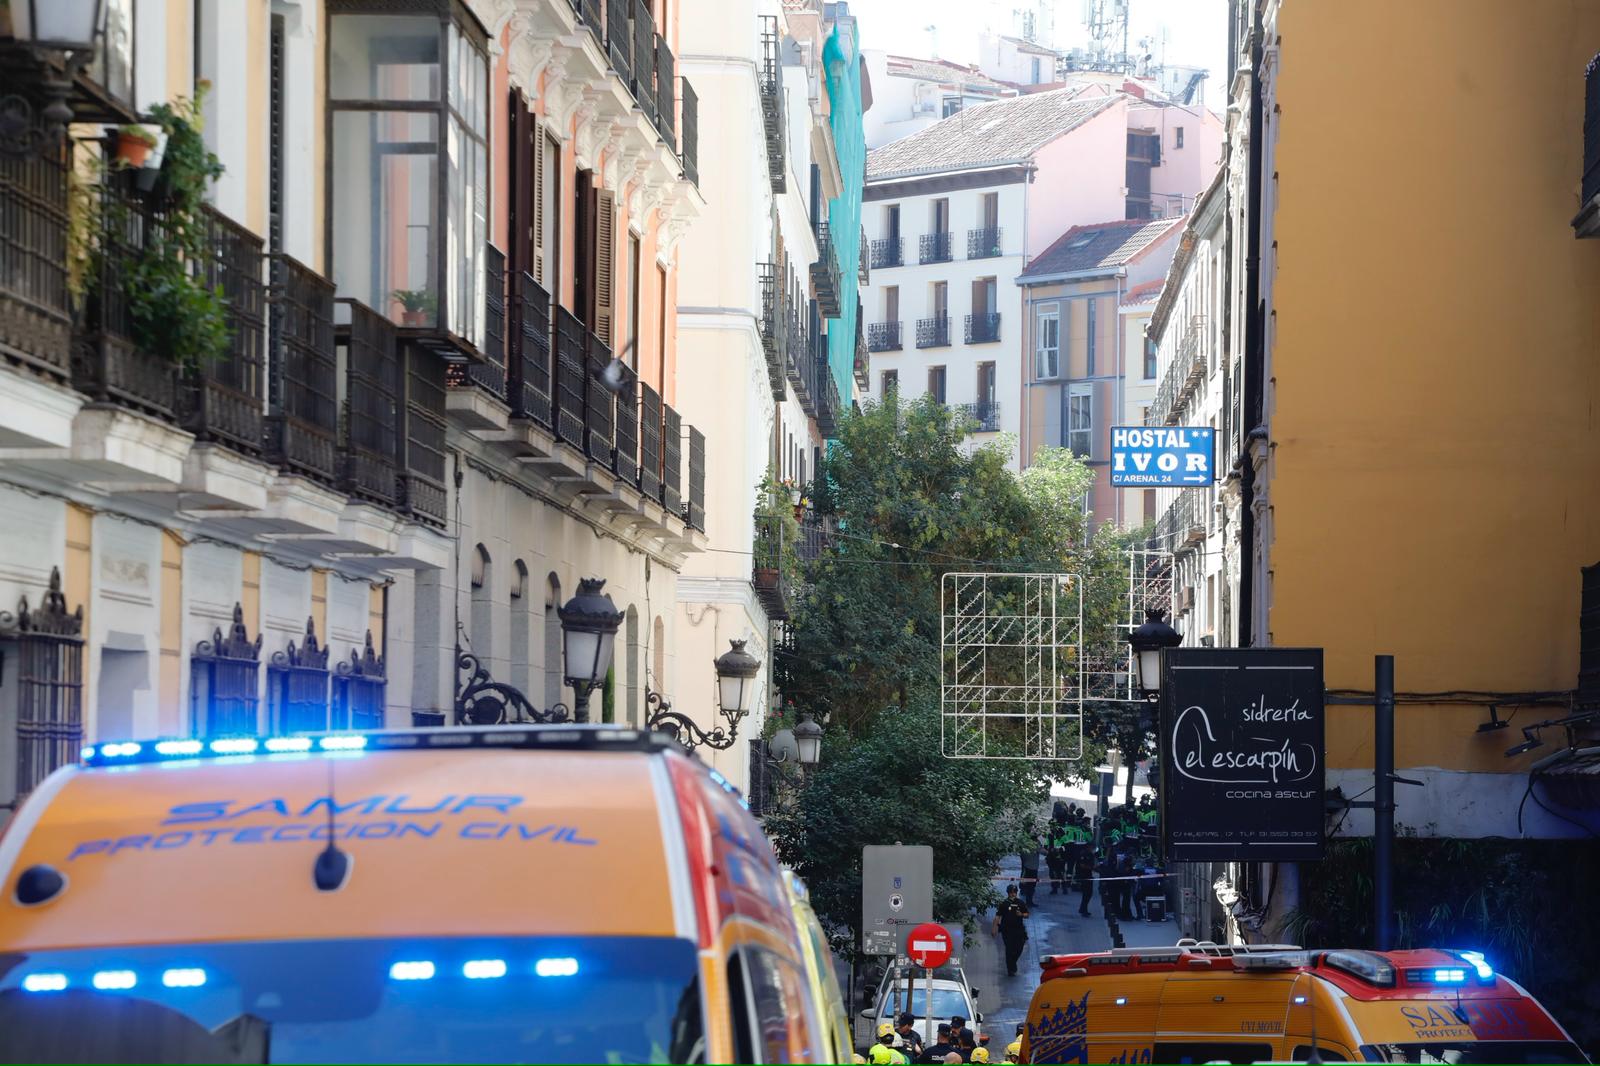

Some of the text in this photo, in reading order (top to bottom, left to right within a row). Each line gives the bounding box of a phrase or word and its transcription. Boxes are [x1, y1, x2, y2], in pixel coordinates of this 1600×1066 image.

[1113, 429, 1190, 448] HOSTAL
[1113, 452, 1208, 472] IVOR
[1113, 475, 1172, 483] C/ ARENAL 24
[1242, 694, 1314, 722] sidrería
[1211, 738, 1302, 784] escarpín
[1225, 790, 1318, 799] cocina astur
[161, 795, 524, 825] SAMUR
[458, 821, 598, 845] CIVIL
